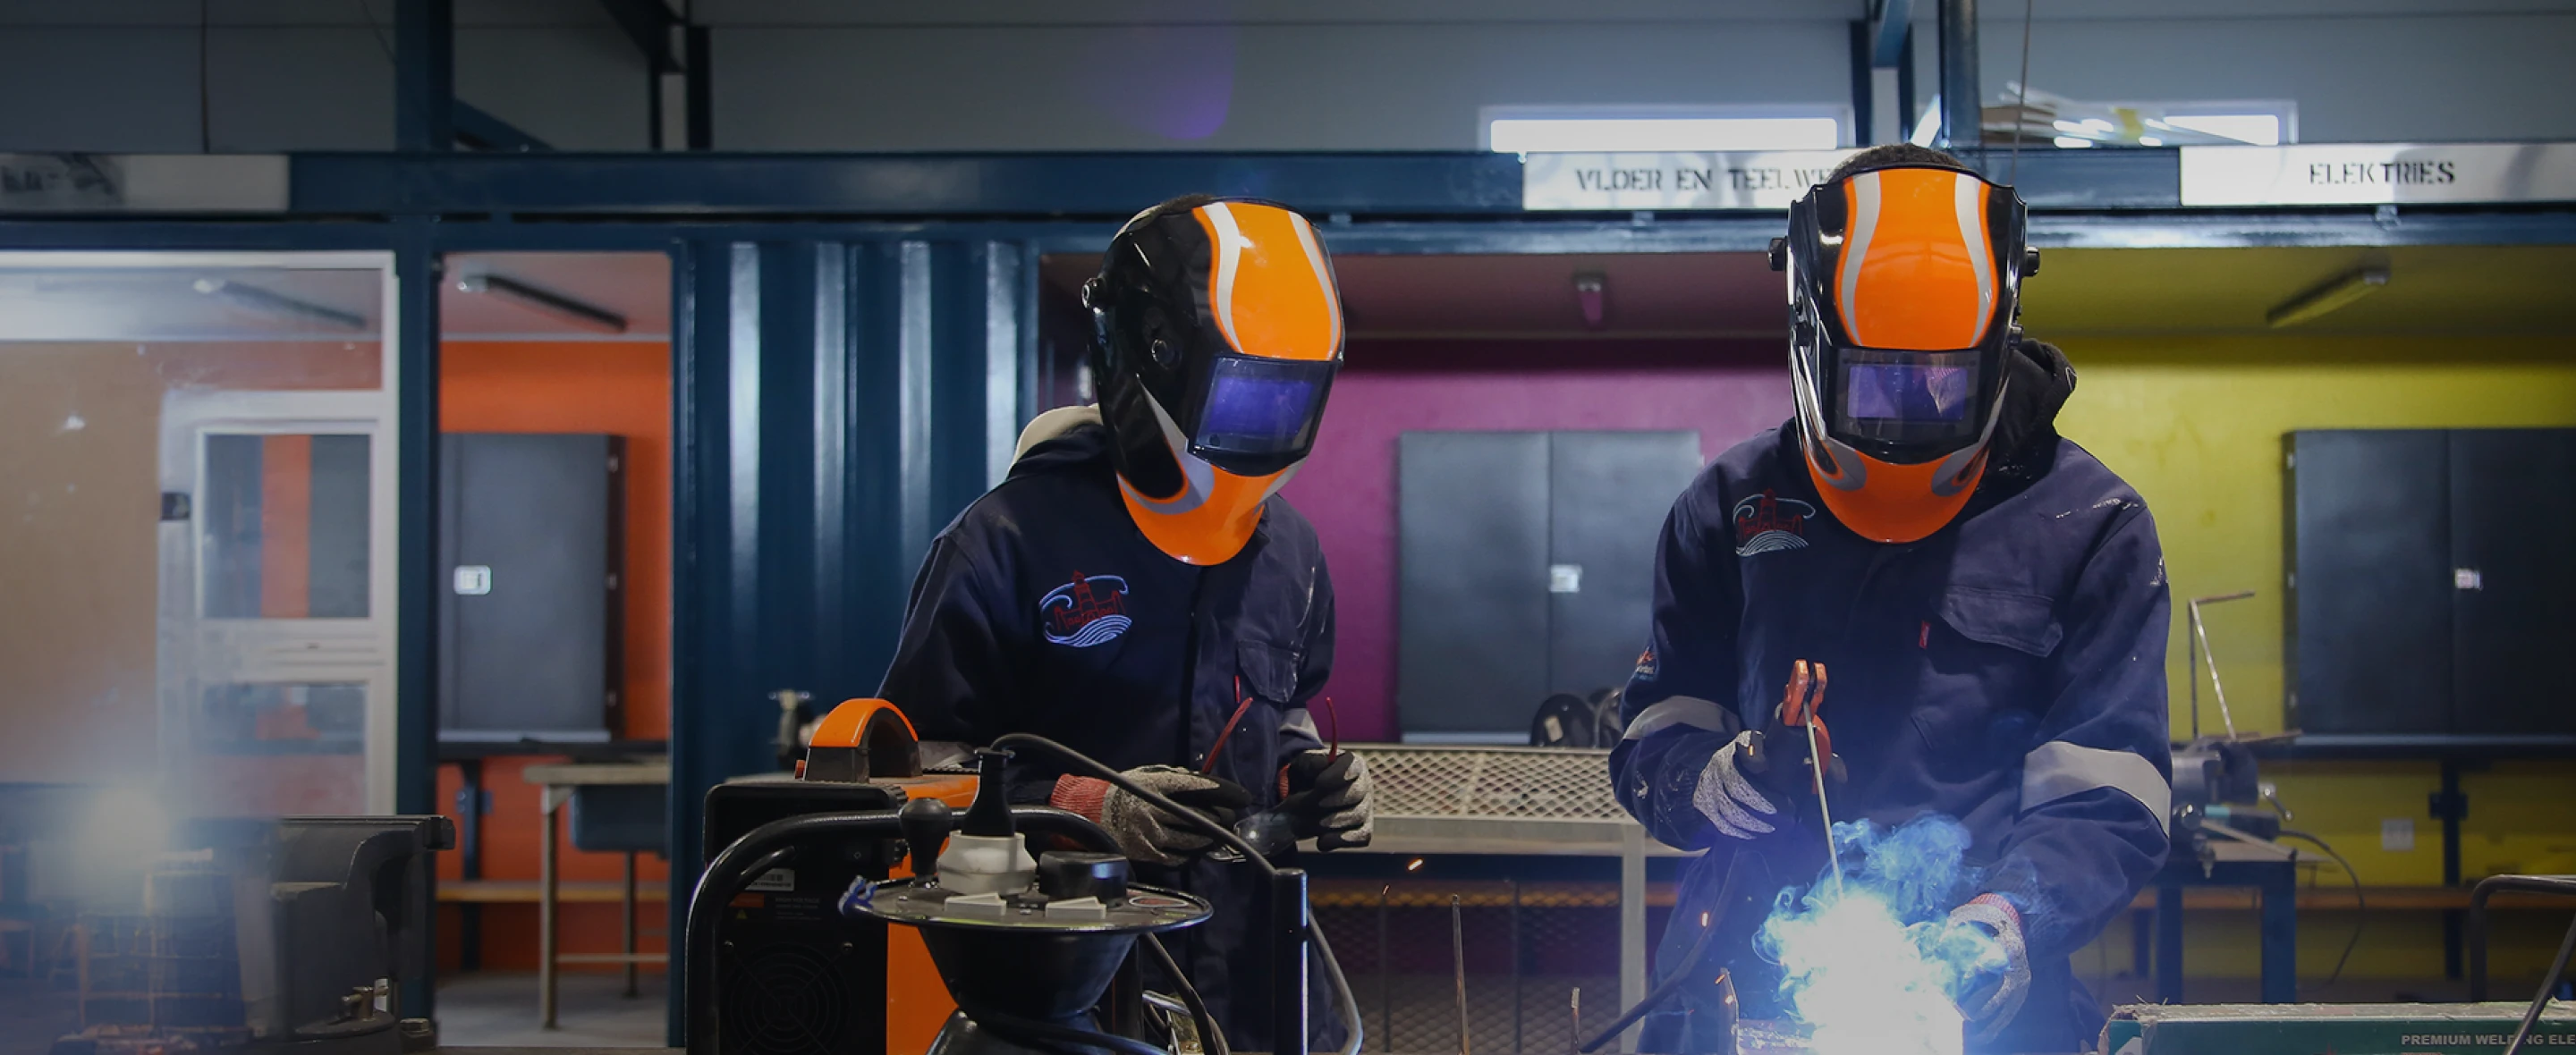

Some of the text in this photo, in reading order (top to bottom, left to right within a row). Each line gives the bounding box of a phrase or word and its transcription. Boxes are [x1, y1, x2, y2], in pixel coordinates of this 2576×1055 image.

[1577, 168, 1661, 190] VLOER
[1676, 168, 1712, 190] EN
[2309, 161, 2456, 184] ELEKTRIES
[2401, 1034, 2471, 1045] PREMIUM
[2548, 1034, 2576, 1045] ELE
